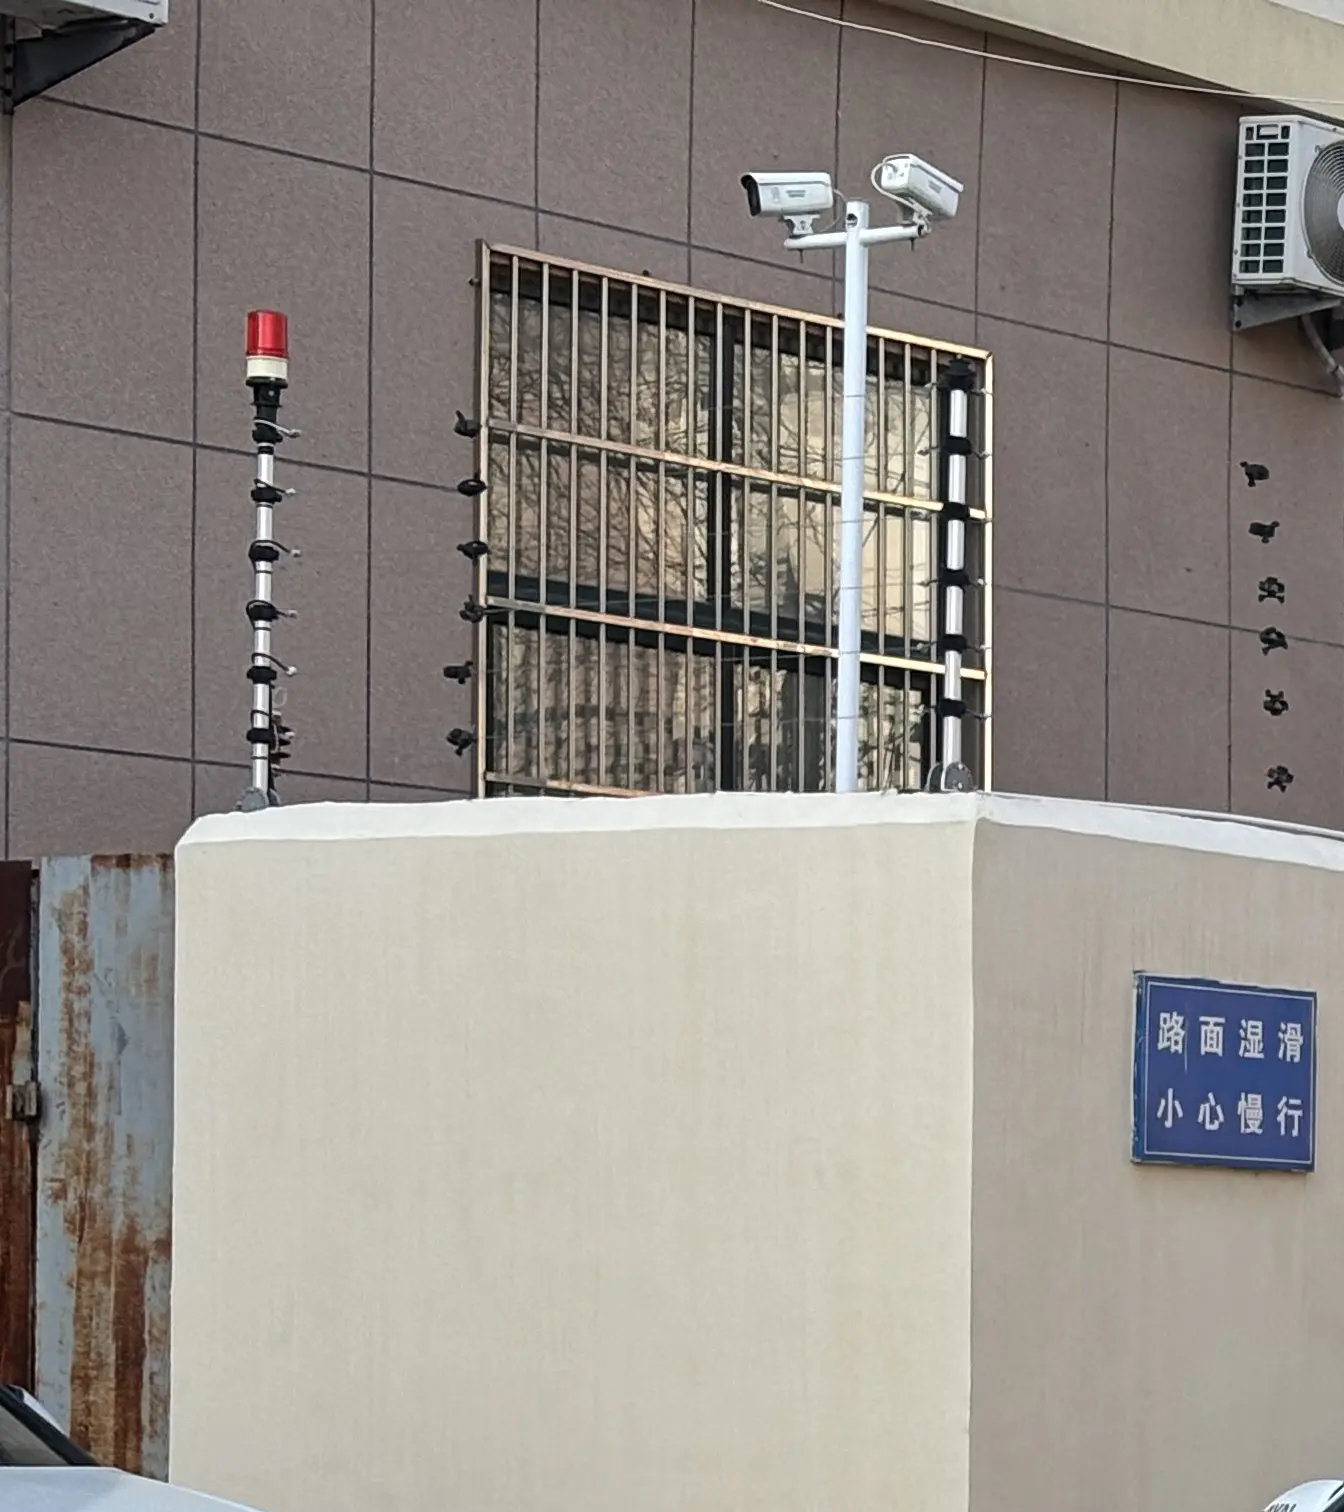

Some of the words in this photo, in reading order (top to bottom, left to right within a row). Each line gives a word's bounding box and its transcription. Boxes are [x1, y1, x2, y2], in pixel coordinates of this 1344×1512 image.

[1157, 1011, 1303, 1063] 路面湿滑
[1156, 1088, 1303, 1137] 小心慢行
